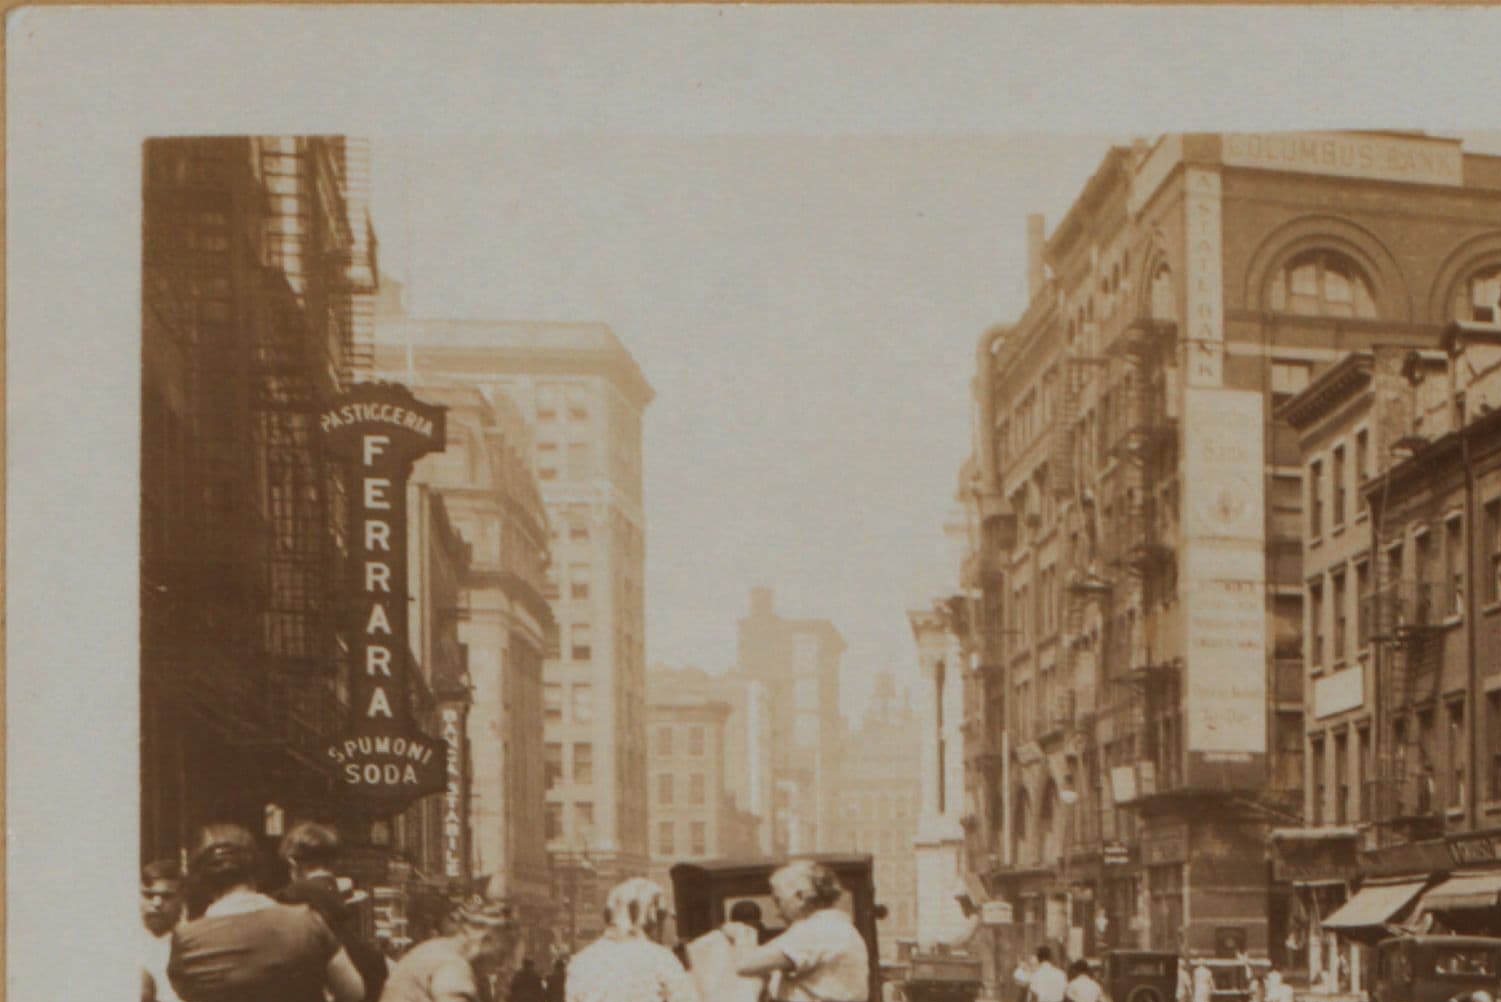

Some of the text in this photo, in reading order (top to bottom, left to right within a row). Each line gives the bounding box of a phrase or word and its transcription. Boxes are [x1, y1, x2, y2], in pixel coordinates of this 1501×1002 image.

[1386, 144, 1455, 176] BANK
[320, 403, 433, 439] PASTICCERIA
[363, 435, 393, 718] FERRARA
[328, 735, 433, 766] SPUMONI
[346, 763, 418, 785] SODA
